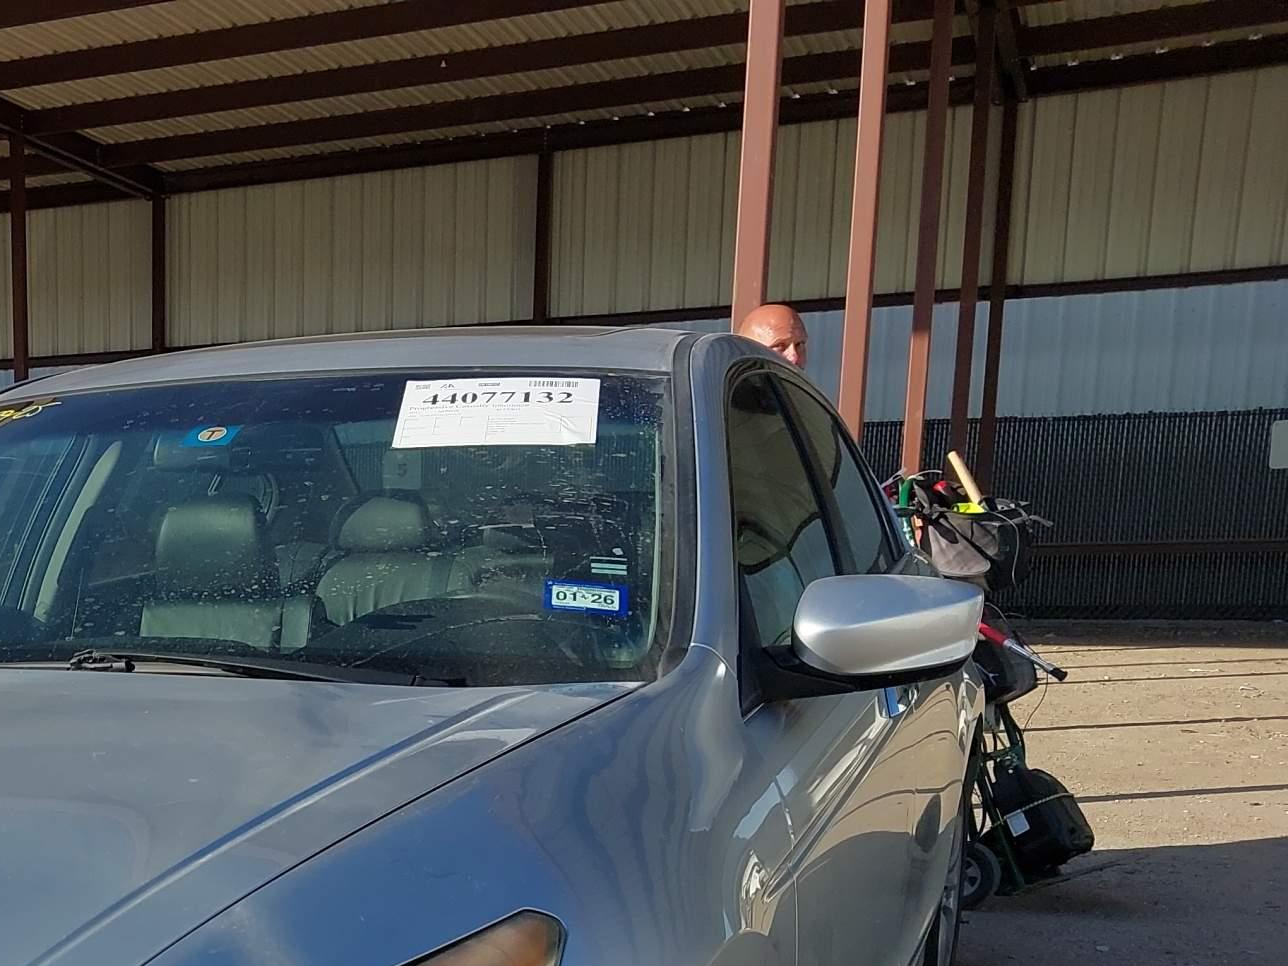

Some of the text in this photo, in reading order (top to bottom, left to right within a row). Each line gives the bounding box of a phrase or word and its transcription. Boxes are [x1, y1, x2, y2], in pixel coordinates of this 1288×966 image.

[422, 391, 574, 405] 44077132
[555, 590, 615, 605] 01 26
